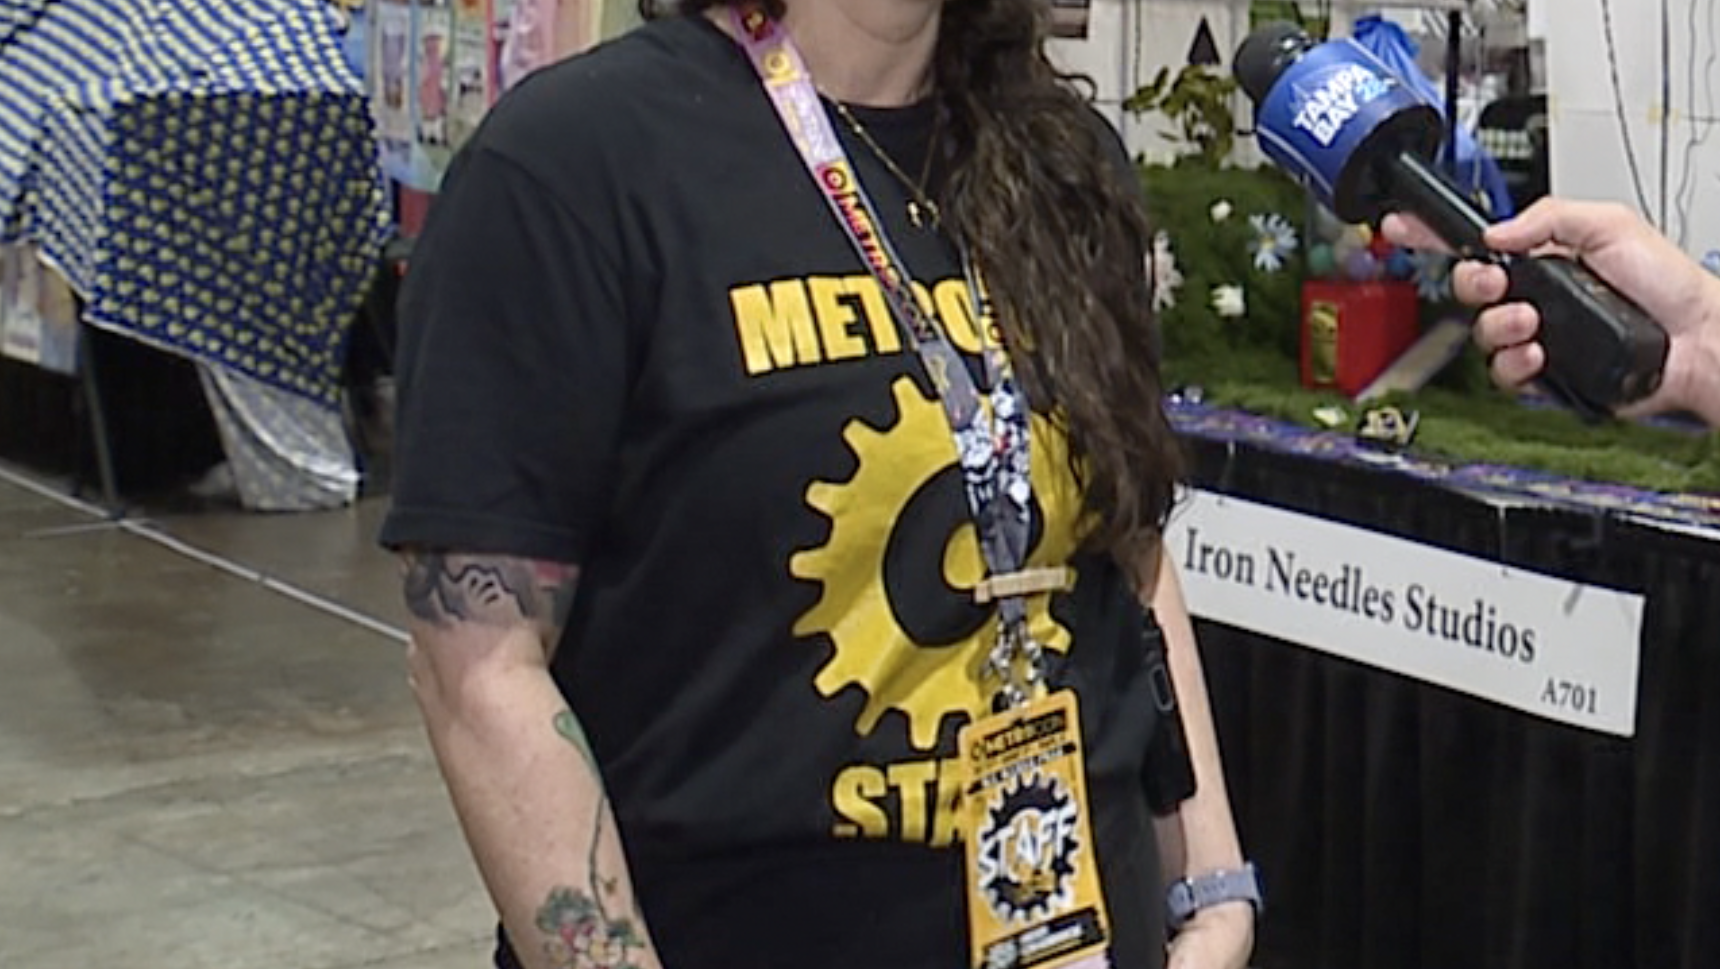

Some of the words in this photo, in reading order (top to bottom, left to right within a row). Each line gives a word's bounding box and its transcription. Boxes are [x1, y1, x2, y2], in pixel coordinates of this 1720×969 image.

[1292, 63, 1376, 131] TAMPA
[1311, 91, 1359, 147] BAY
[1184, 528, 1256, 585] Iron
[1264, 548, 1396, 623] Needles
[1403, 583, 1537, 664] Studios
[1540, 677, 1598, 715] A701
[832, 757, 968, 849] STA
[978, 802, 1078, 891] STAFF
